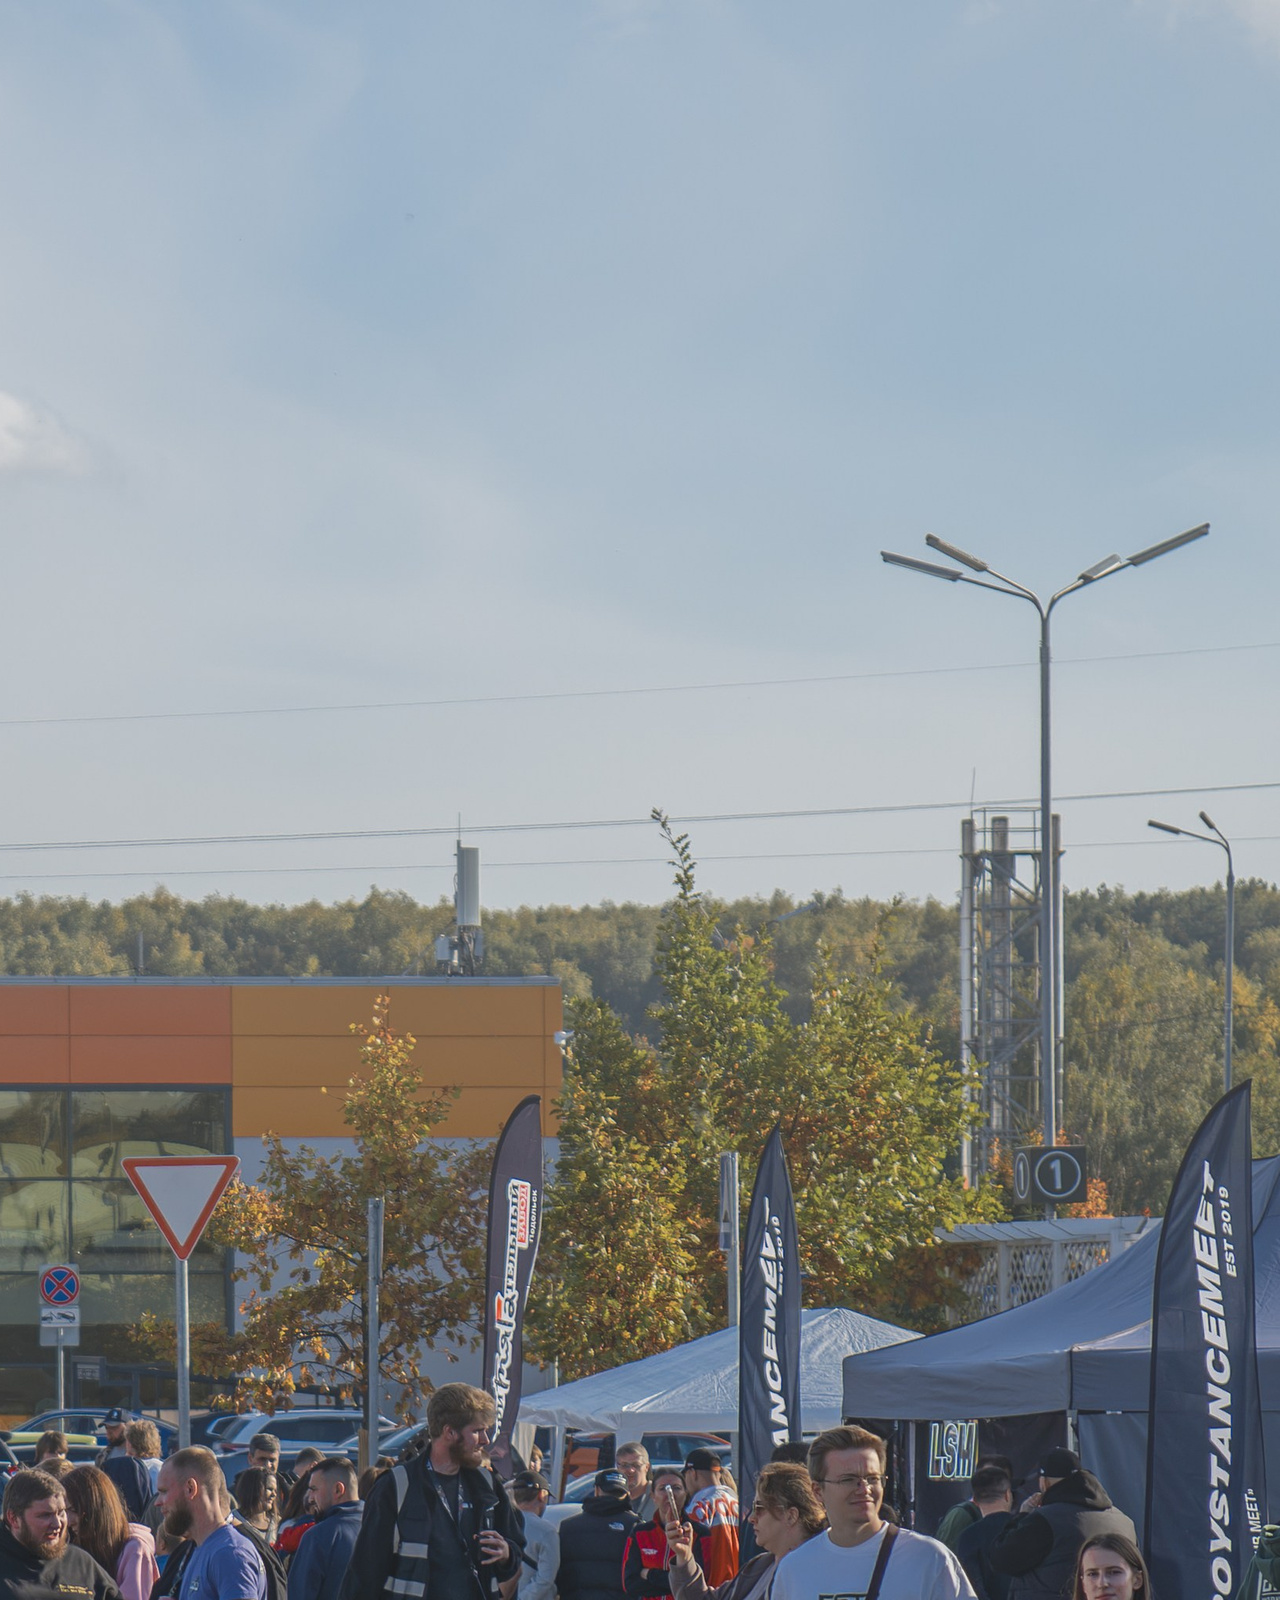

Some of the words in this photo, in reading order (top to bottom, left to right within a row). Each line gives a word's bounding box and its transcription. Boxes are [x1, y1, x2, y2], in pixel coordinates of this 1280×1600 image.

[1050, 1159, 1062, 1190] 1
[517, 1184, 528, 1242] ЗАВОД
[529, 1189, 538, 1243] Подольск
[1219, 1186, 1232, 1236] 2019
[1224, 1238, 1237, 1278] EST
[929, 1423, 976, 1478] LSM
